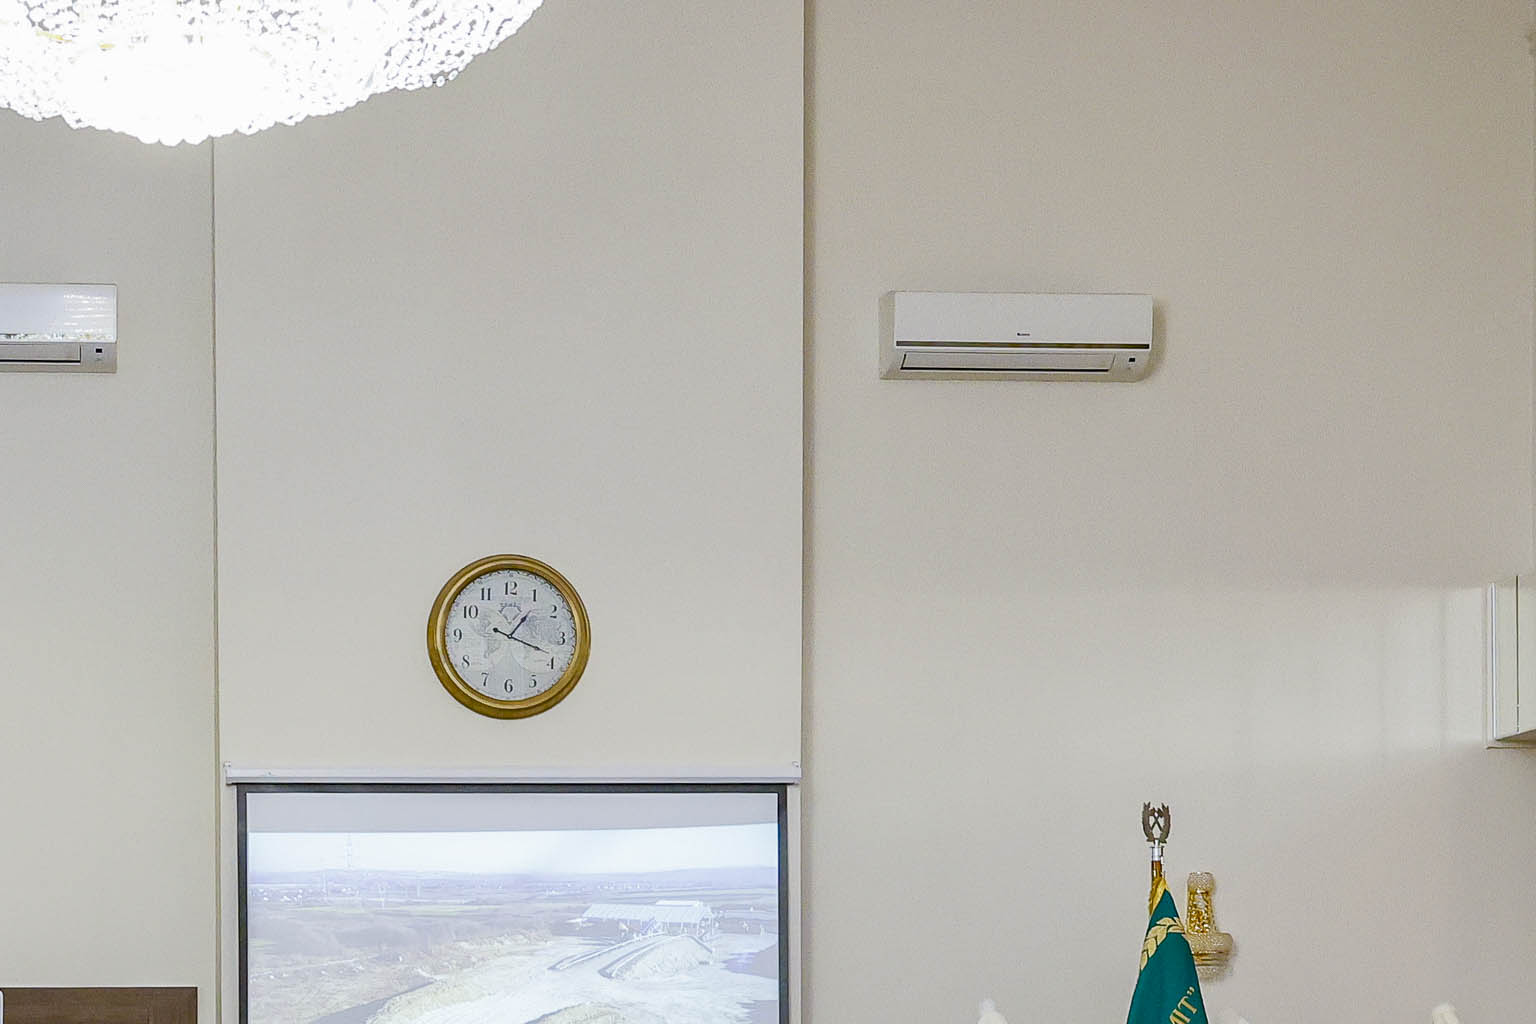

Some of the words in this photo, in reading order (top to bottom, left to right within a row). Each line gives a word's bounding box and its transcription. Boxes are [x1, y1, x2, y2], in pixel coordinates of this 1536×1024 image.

[480, 587, 492, 601] 11
[504, 581, 518, 596] 12
[531, 589, 537, 602] 1
[463, 605, 479, 619] 10
[549, 605, 558, 619] 2
[453, 628, 463, 643] 9
[558, 632, 566, 646] 3
[462, 655, 471, 668] 8
[546, 656, 555, 670] 4
[481, 673, 490, 687] 7
[504, 679, 514, 693] 6
[528, 674, 538, 689] 5
